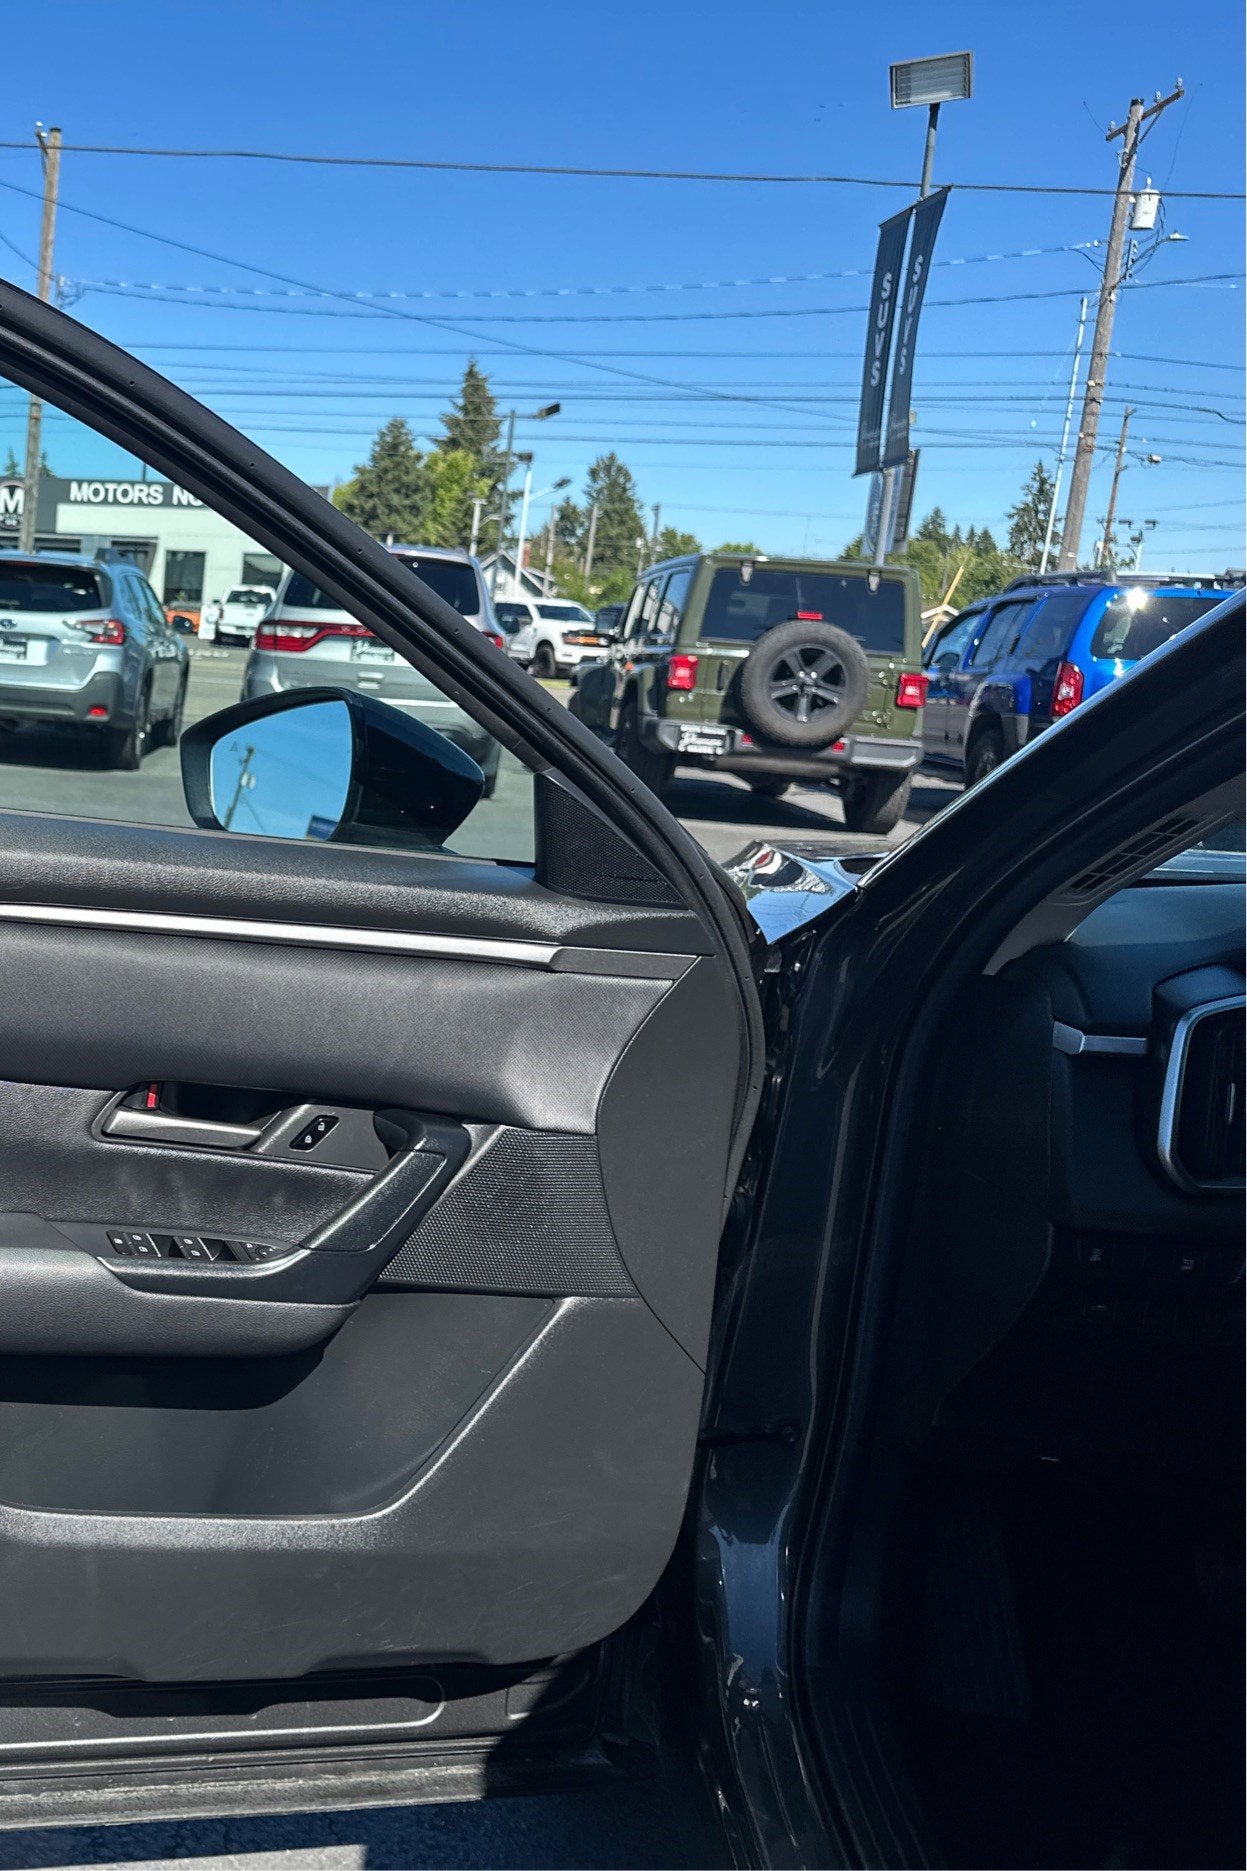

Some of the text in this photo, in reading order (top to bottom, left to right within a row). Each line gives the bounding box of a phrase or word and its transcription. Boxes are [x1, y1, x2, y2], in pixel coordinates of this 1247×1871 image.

[870, 272, 893, 387] SUVS
[899, 254, 924, 375] SUVS
[69, 481, 164, 505] MOTORS
